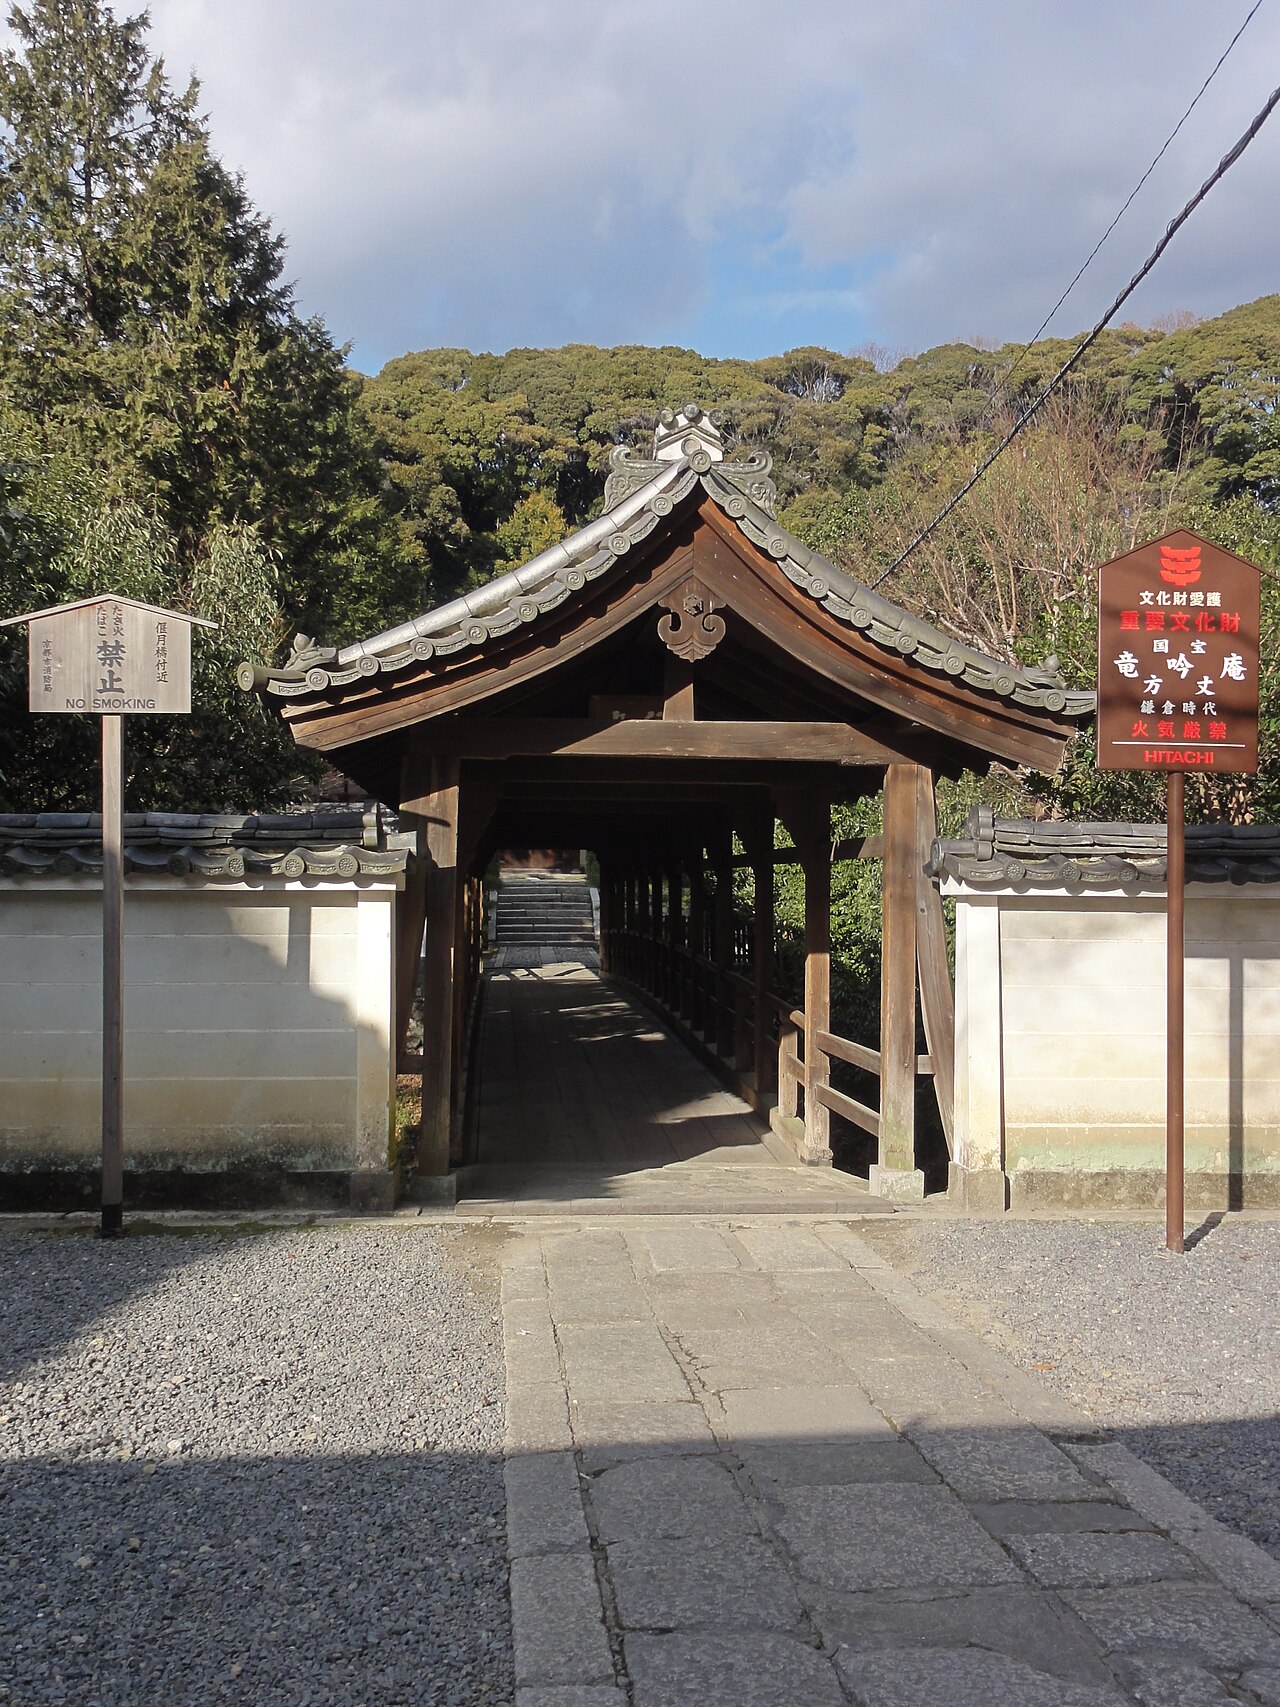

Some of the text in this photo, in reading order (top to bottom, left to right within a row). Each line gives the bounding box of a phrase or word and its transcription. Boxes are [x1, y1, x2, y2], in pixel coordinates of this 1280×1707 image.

[1139, 590, 1222, 607] 文化財愛護
[112, 605, 125, 637] たき火
[1119, 610, 1240, 633] 重要文化財
[1153, 639, 1207, 654] 国宝
[42, 639, 52, 693] 京都市消防局
[96, 640, 127, 694] 禁止
[1113, 650, 1247, 681] 竜吟庵
[1143, 674, 1216, 696] 方丈
[66, 698, 156, 709] NO SMOKING
[1140, 700, 1217, 716] 鎌倉時代
[1131, 720, 1227, 739] 火気厳禁
[1143, 750, 1214, 764] HITACHI
